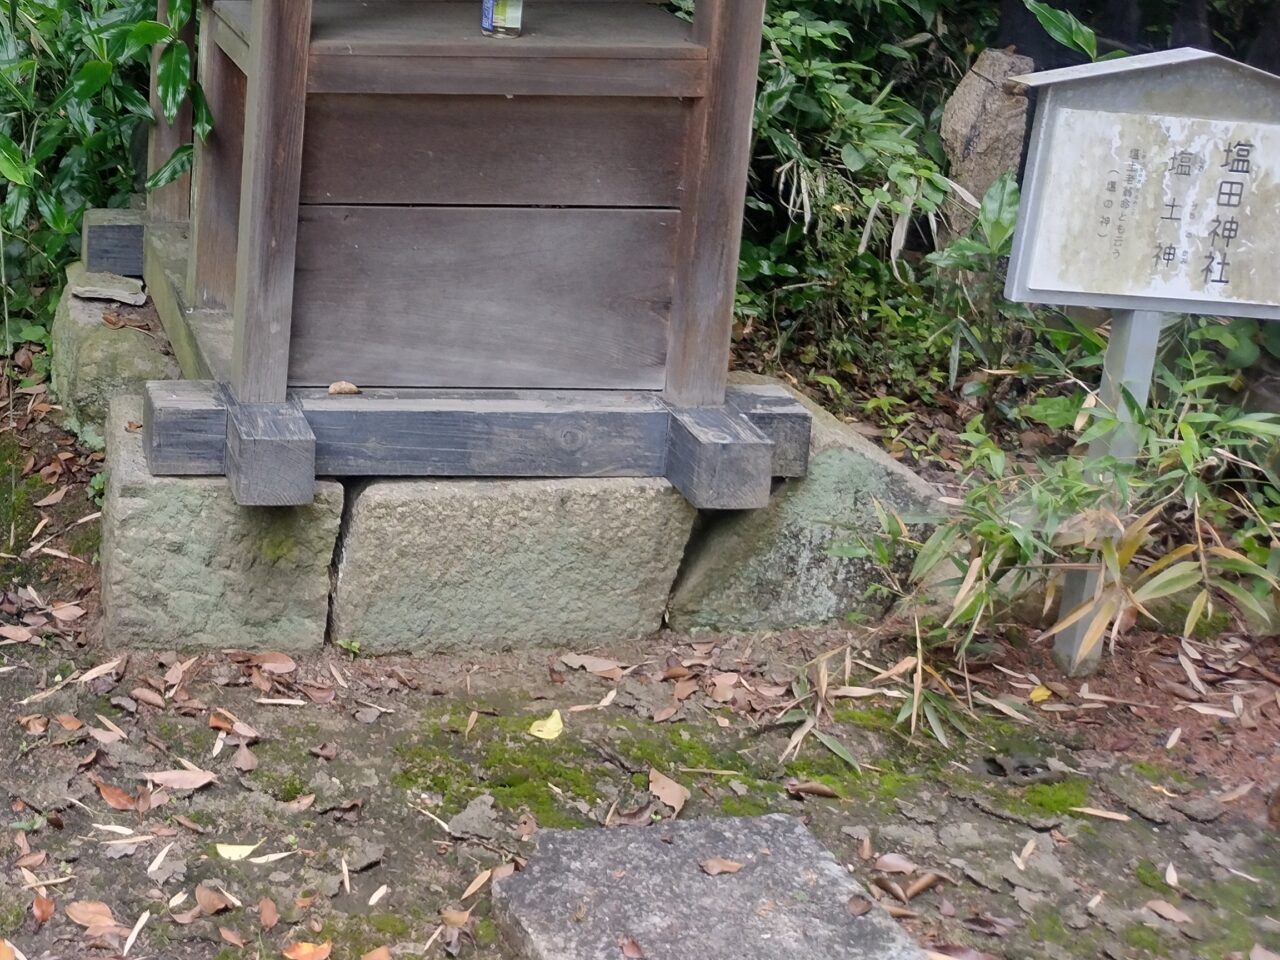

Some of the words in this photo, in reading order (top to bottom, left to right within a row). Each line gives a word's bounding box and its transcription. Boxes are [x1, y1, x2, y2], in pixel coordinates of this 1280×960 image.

[1152, 151, 1193, 268] 塩土神
[1201, 141, 1254, 284] 塩田神社
